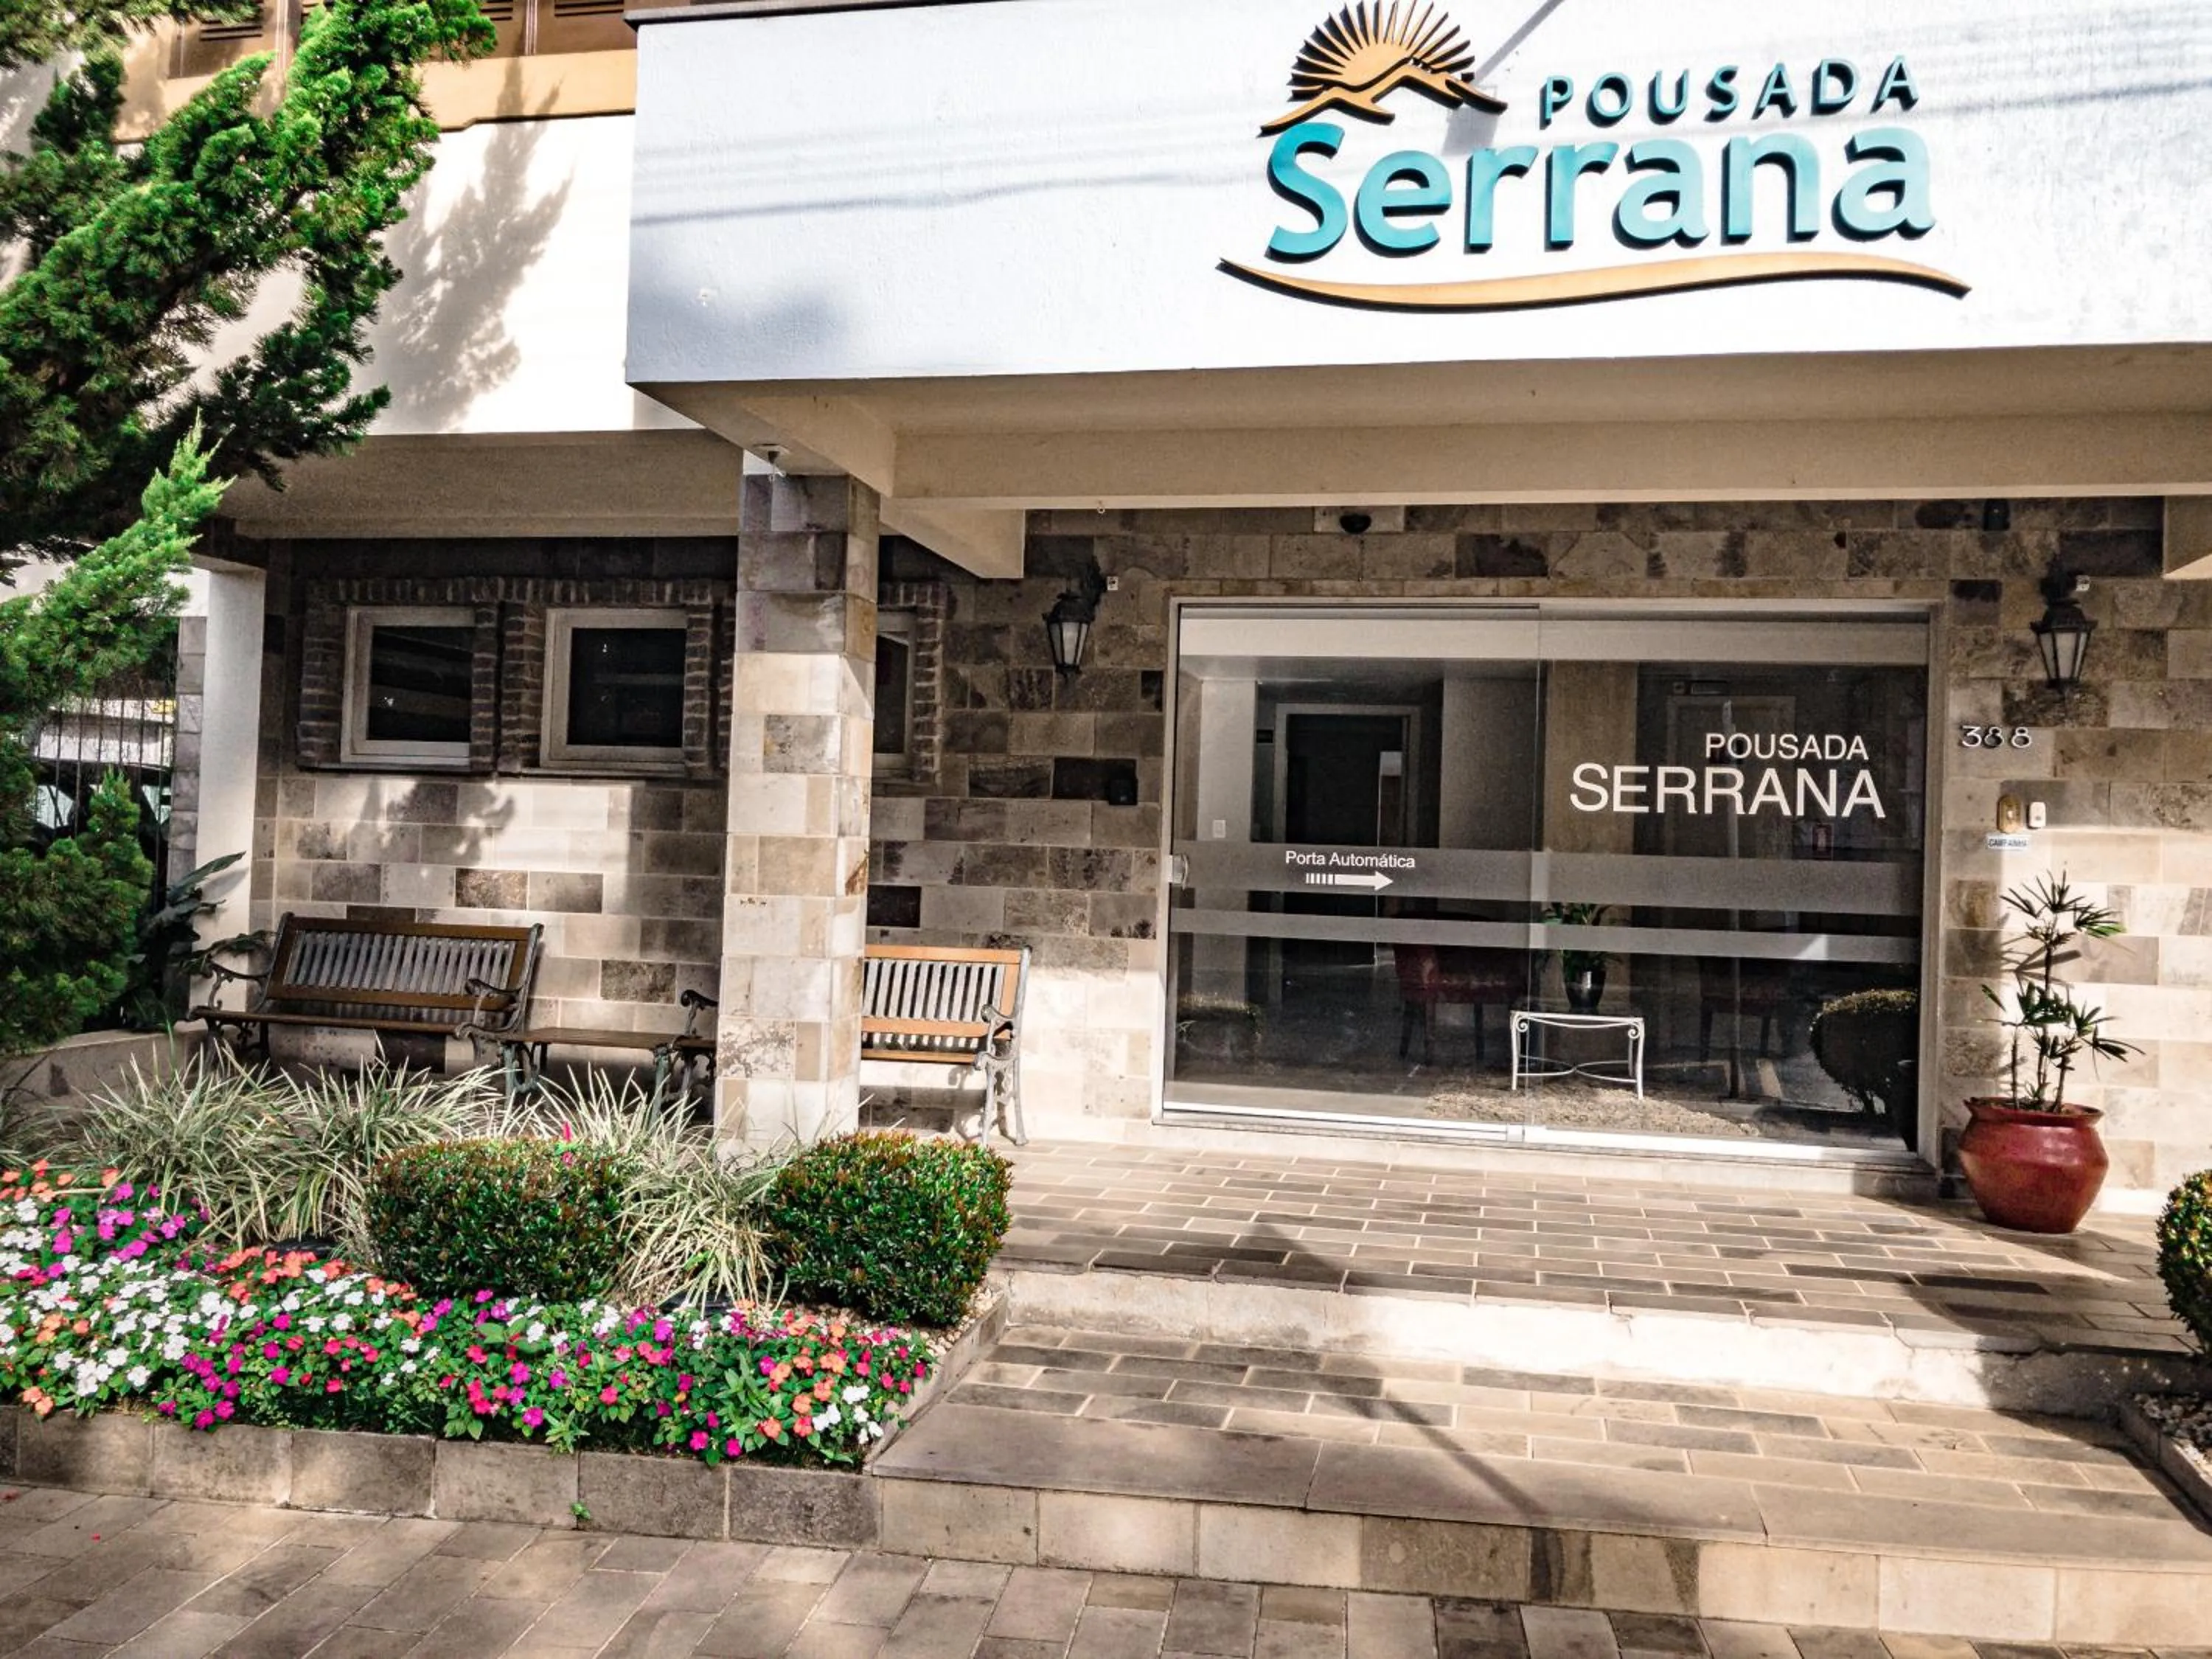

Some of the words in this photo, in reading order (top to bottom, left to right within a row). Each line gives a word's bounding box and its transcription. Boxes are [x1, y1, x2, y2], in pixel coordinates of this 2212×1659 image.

[1543, 57, 1919, 128] POUSADA
[1267, 122, 1936, 262] Serrana
[1705, 733, 1869, 760] POUSADA
[1961, 725, 2031, 748] 388
[1570, 762, 1886, 818] SERRANA
[1285, 850, 1326, 866] Porta
[1329, 852, 1416, 869] Automática
